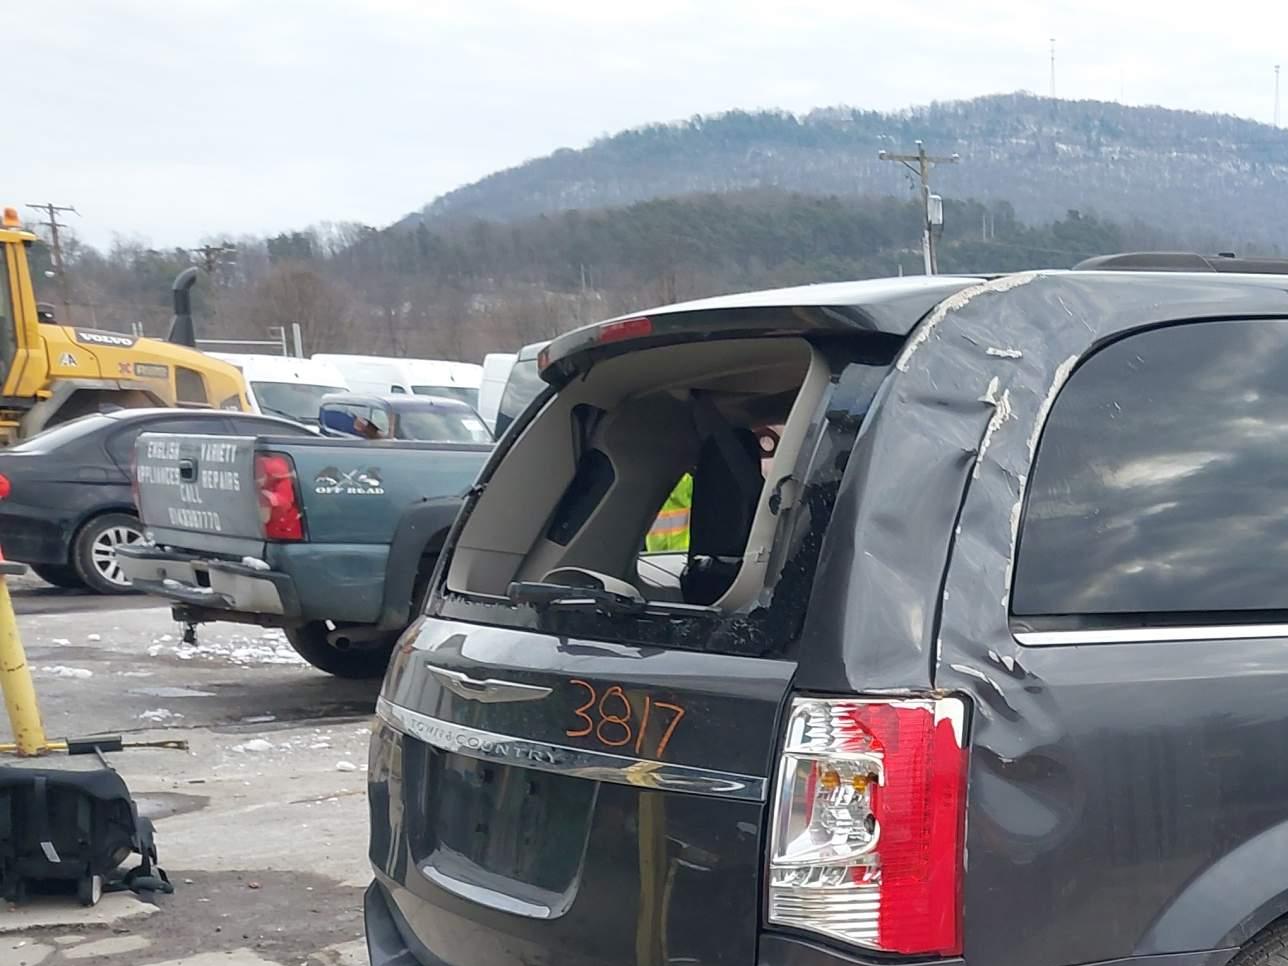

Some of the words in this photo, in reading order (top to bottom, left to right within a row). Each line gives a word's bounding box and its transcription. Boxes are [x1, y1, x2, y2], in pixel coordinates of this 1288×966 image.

[79, 332, 133, 346] VOLVO
[202, 470, 240, 491] REPAIRS
[180, 484, 203, 504] CALL
[566, 679, 685, 759] 3817
[454, 732, 556, 764] COUNTRY
